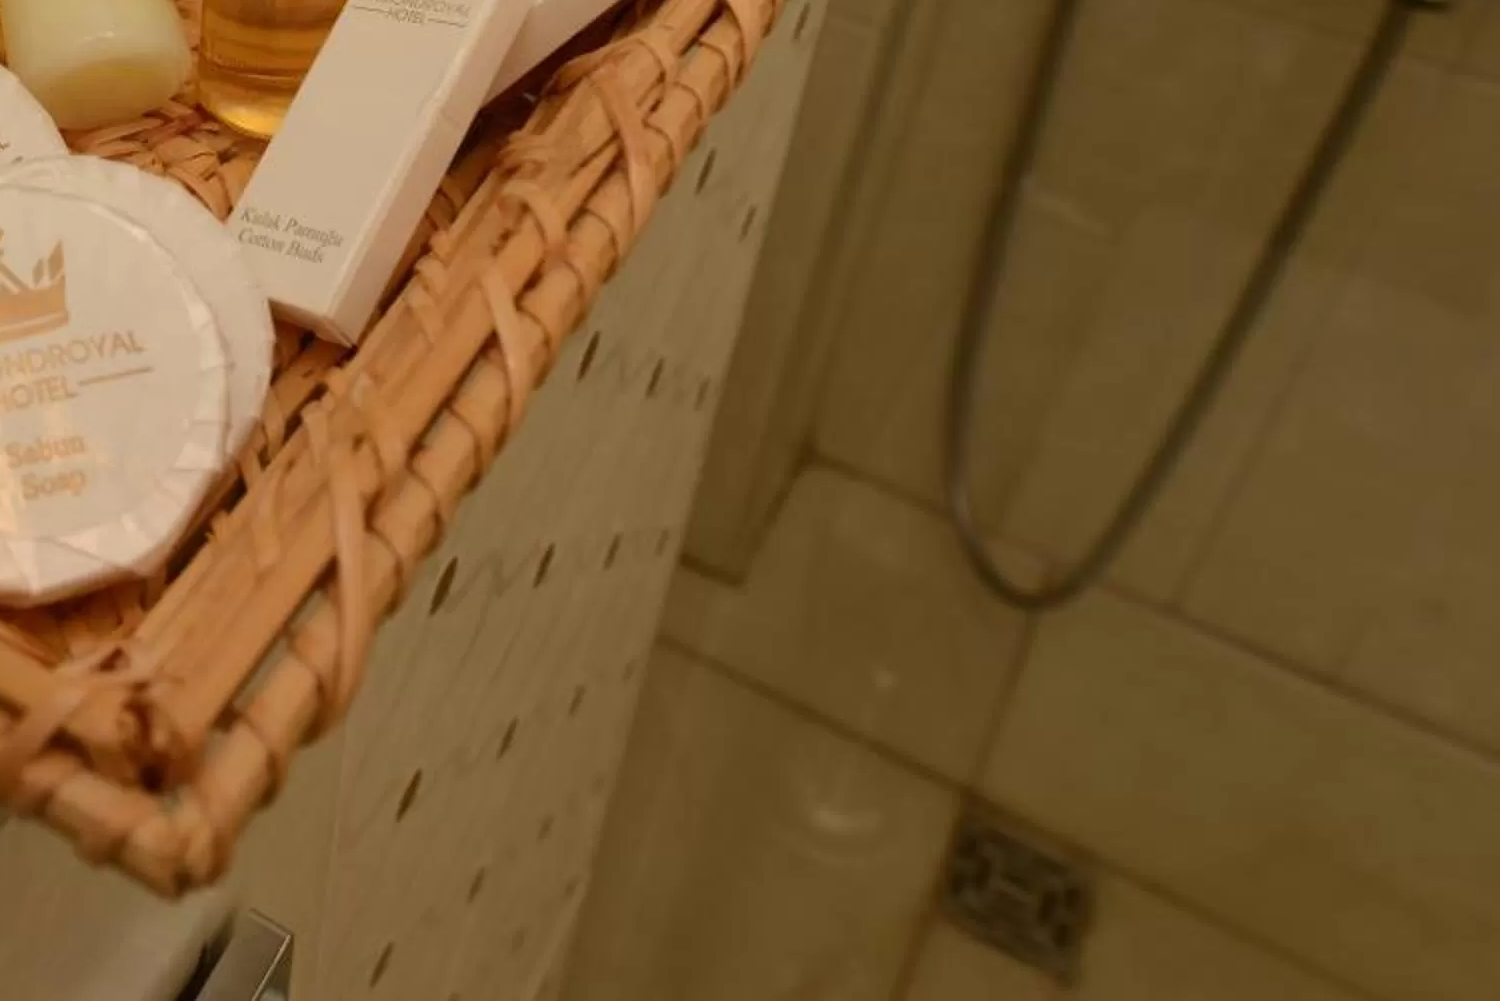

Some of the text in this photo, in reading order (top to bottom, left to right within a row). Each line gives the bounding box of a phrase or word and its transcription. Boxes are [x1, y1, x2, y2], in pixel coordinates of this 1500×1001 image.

[237, 227, 324, 264] Cotton Buds
[3, 435, 86, 471] Sabun
[21, 470, 88, 501] Soap
